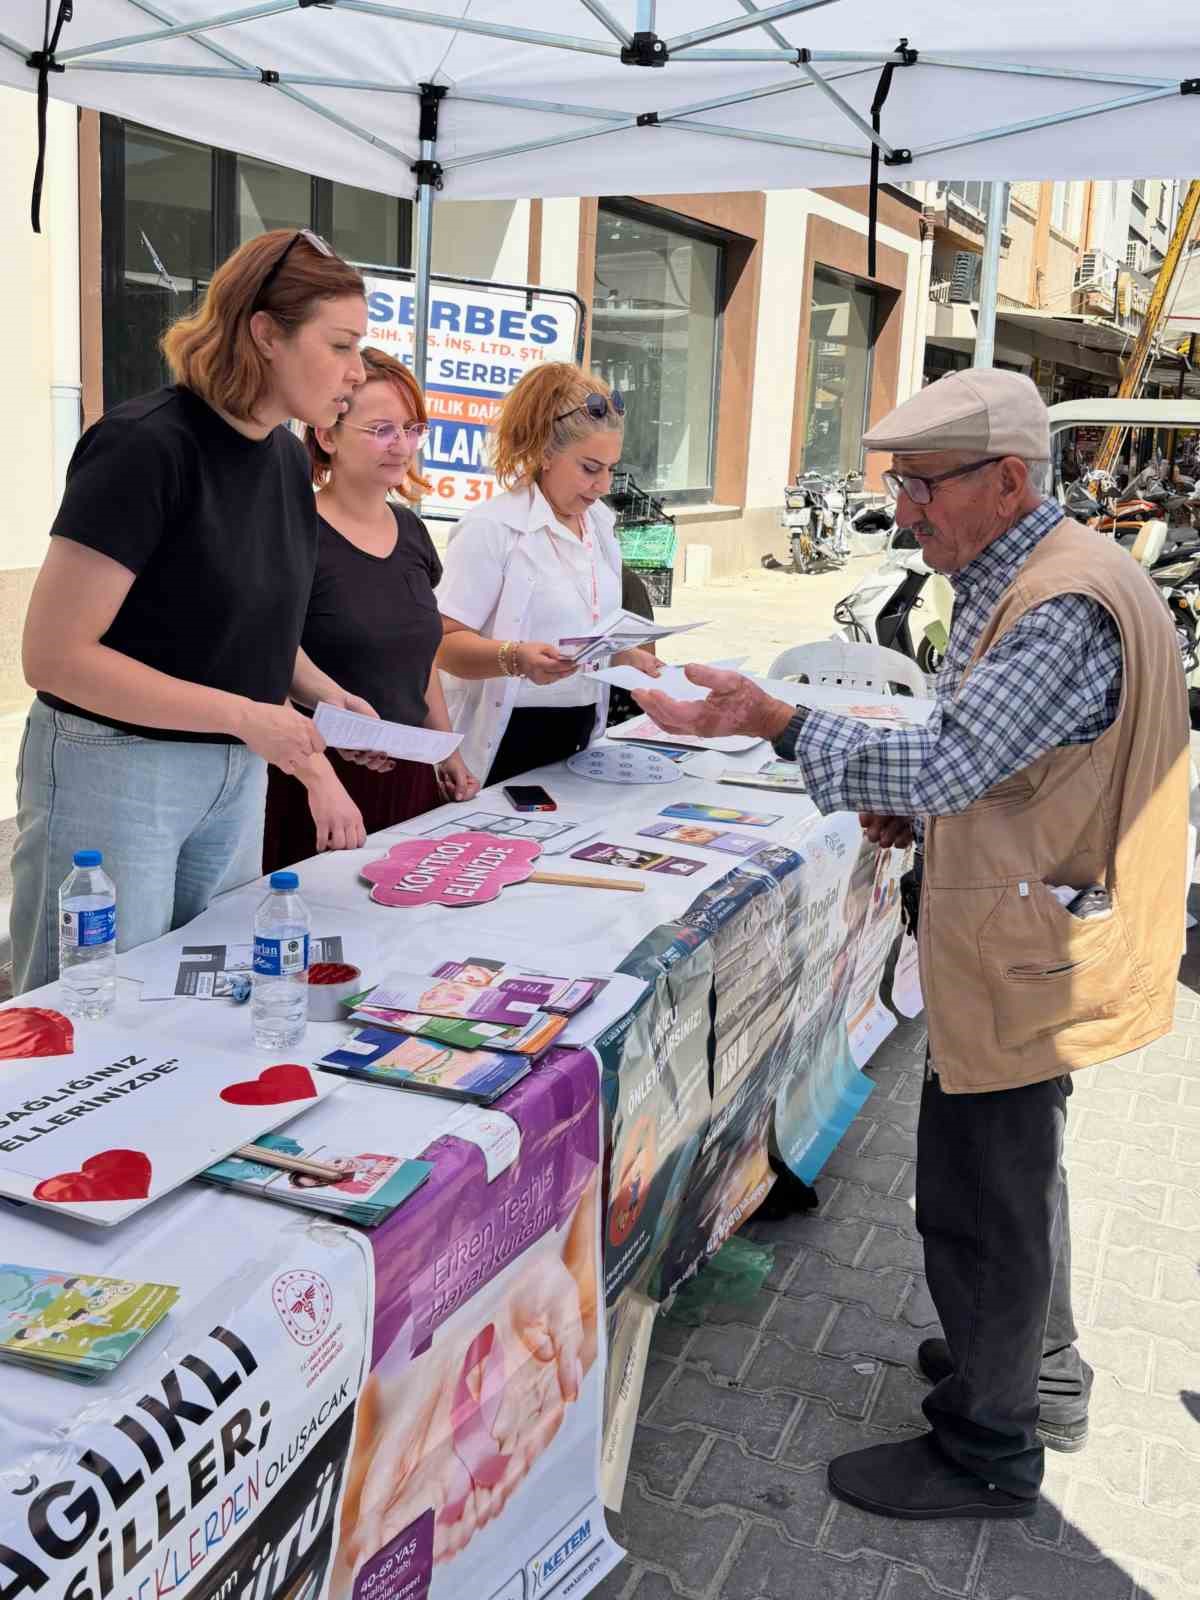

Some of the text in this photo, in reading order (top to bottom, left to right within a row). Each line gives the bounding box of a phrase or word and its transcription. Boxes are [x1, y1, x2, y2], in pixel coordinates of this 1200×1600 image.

[368, 292, 558, 344] SERBES
[407, 331, 440, 346] TS.
[481, 342, 514, 357] LTD.
[440, 359, 523, 386] SERBE
[393, 841, 472, 894] KONTROL
[0, 1325, 258, 1600] AĞLIKLI
[64, 1400, 272, 1600] SİLLER;
[543, 1519, 591, 1578] KETEM
